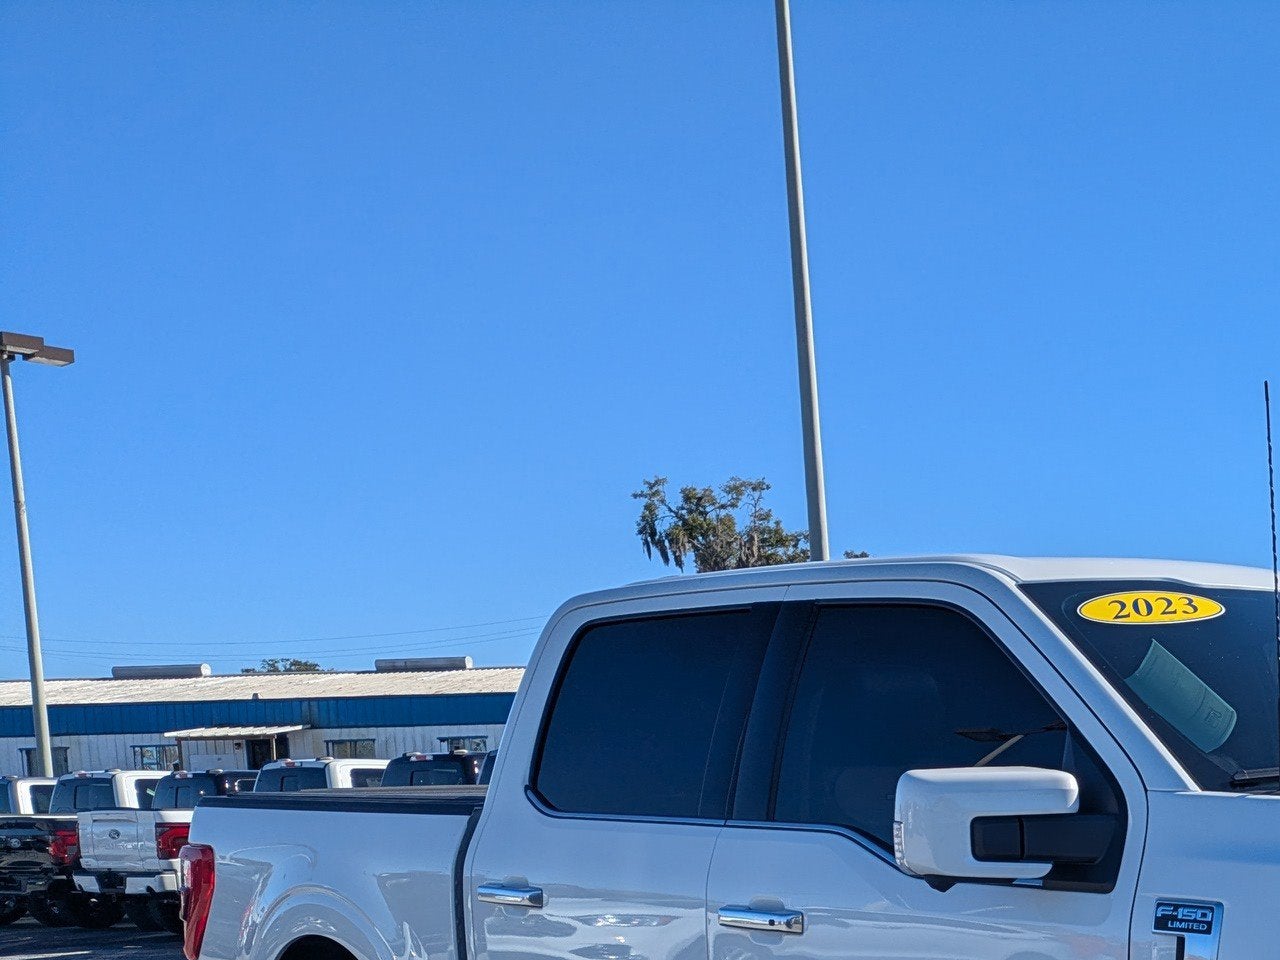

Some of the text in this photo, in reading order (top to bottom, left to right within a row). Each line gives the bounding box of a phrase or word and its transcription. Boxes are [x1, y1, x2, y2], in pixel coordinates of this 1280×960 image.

[1108, 597, 1199, 620] 2023
[1156, 905, 1213, 921] F-150
[1167, 920, 1208, 930] LIMITED
